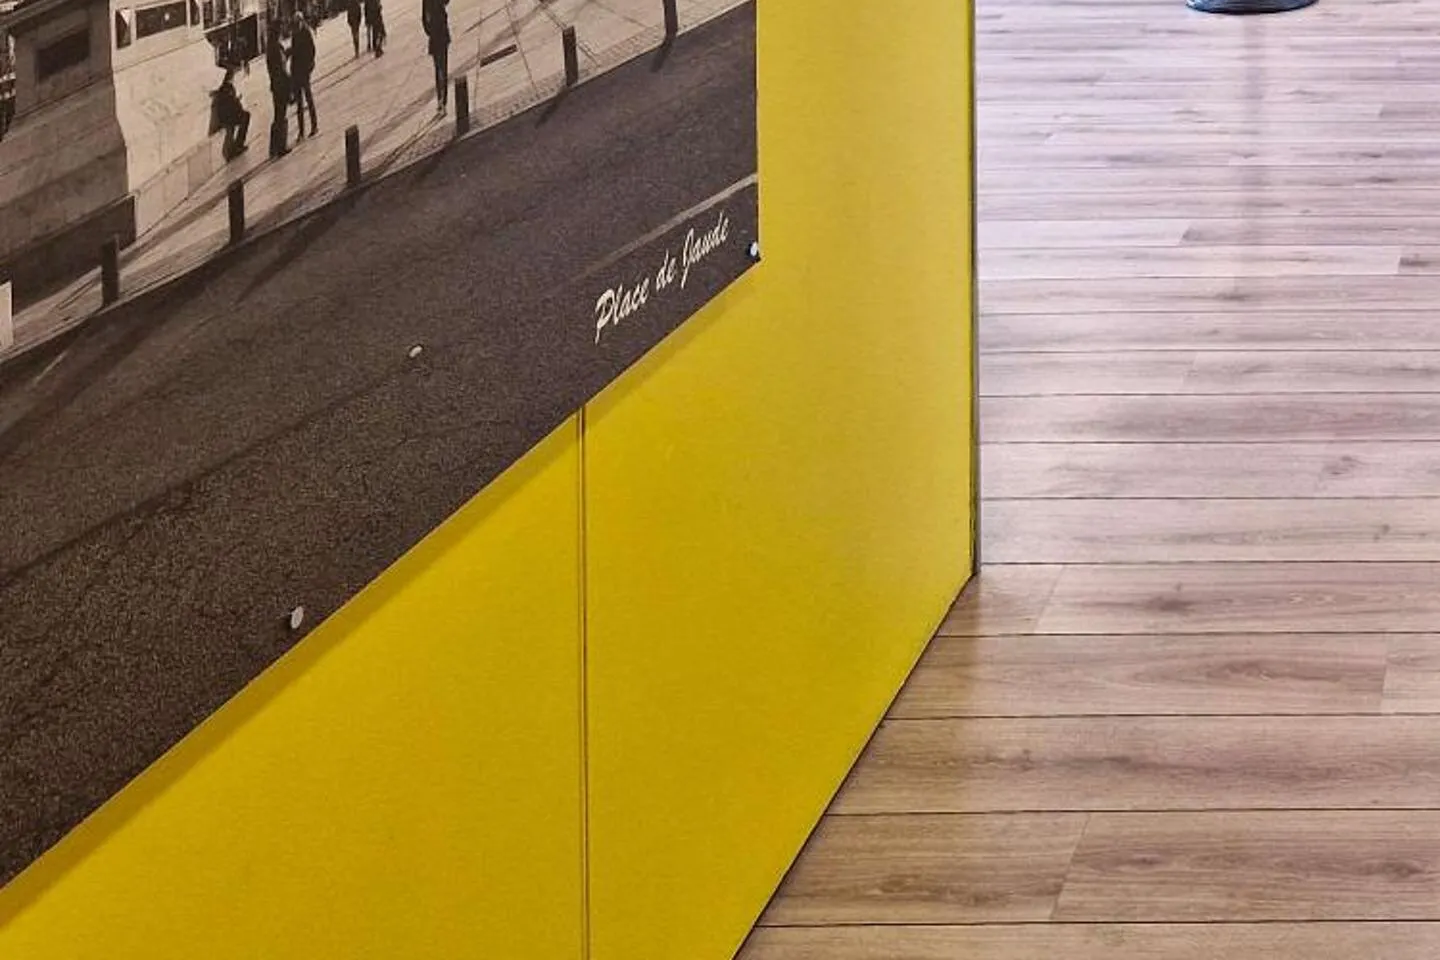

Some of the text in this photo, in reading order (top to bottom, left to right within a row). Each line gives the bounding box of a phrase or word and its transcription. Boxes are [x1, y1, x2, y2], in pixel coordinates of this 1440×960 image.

[595, 210, 729, 344] Place de Jaude
